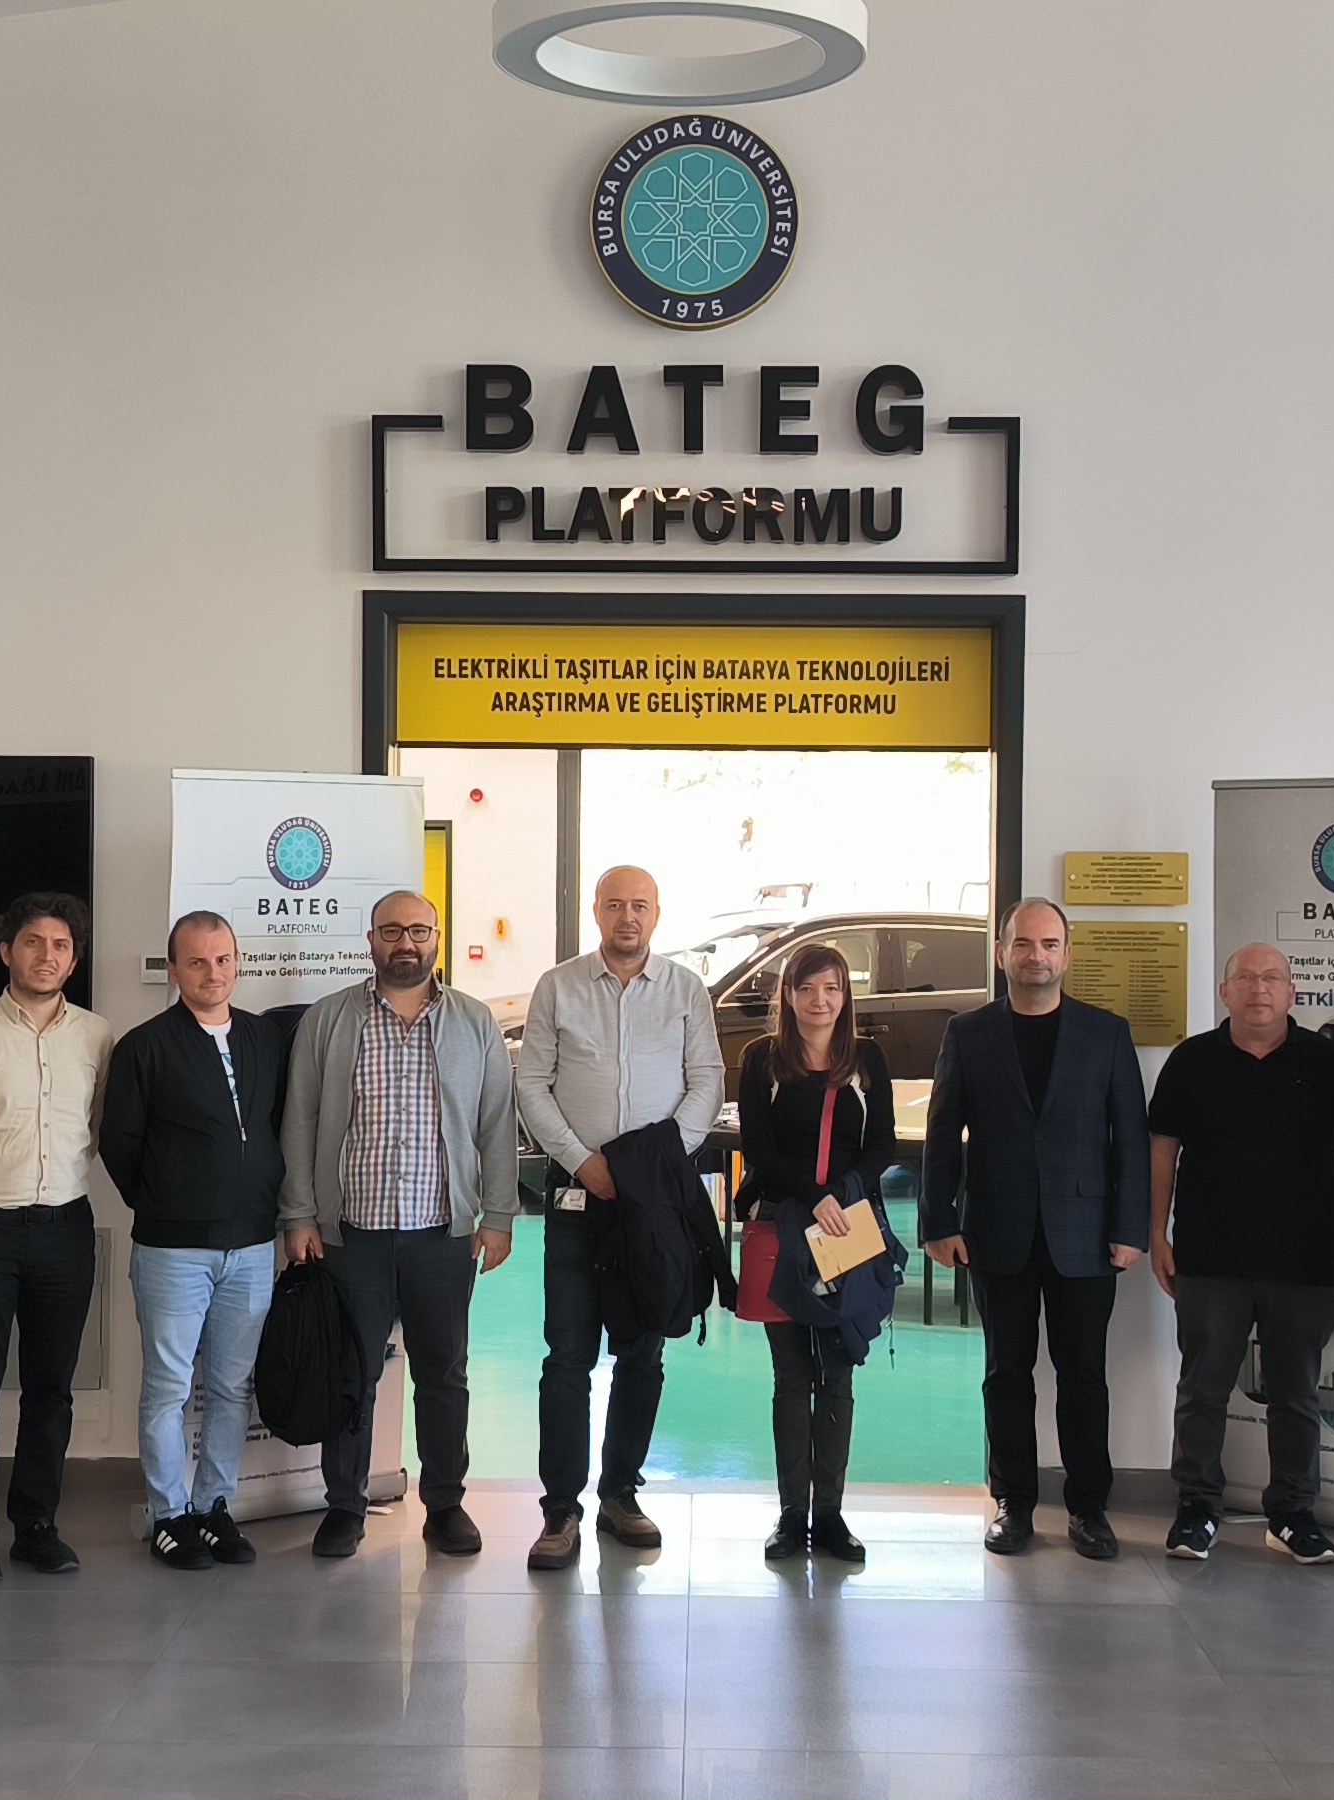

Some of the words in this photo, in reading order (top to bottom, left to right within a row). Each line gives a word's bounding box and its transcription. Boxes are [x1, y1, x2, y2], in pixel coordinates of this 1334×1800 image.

[597, 179, 621, 257] BURSA
[614, 118, 702, 173] ULUDAĞ
[711, 121, 794, 257] ÜNİVERSİTESİ
[661, 299, 724, 318] 1975
[465, 363, 925, 456] BATEG
[485, 486, 903, 544] PLATFORMU
[433, 653, 549, 681] ELEKTRİKLİ
[554, 658, 649, 685] TAŞITLAR
[655, 653, 697, 685] İÇİN
[703, 659, 790, 682] BATARYA
[797, 656, 951, 686] TEKNOLOJİLERİ
[491, 691, 610, 718] ARAŞTIRMA
[615, 692, 640, 713] VE
[647, 687, 768, 719] GELİŞTİRME
[774, 693, 897, 716] PLATFORMU
[1313, 845, 1322, 873] BURSA
[257, 898, 339, 916] BATEG
[267, 924, 328, 935] PLATFORMU
[242, 952, 277, 963] Taşıtlar
[299, 951, 335, 962] Batarya
[1288, 956, 1325, 967] Taşıtlar
[279, 967, 327, 978] Geliştirme
